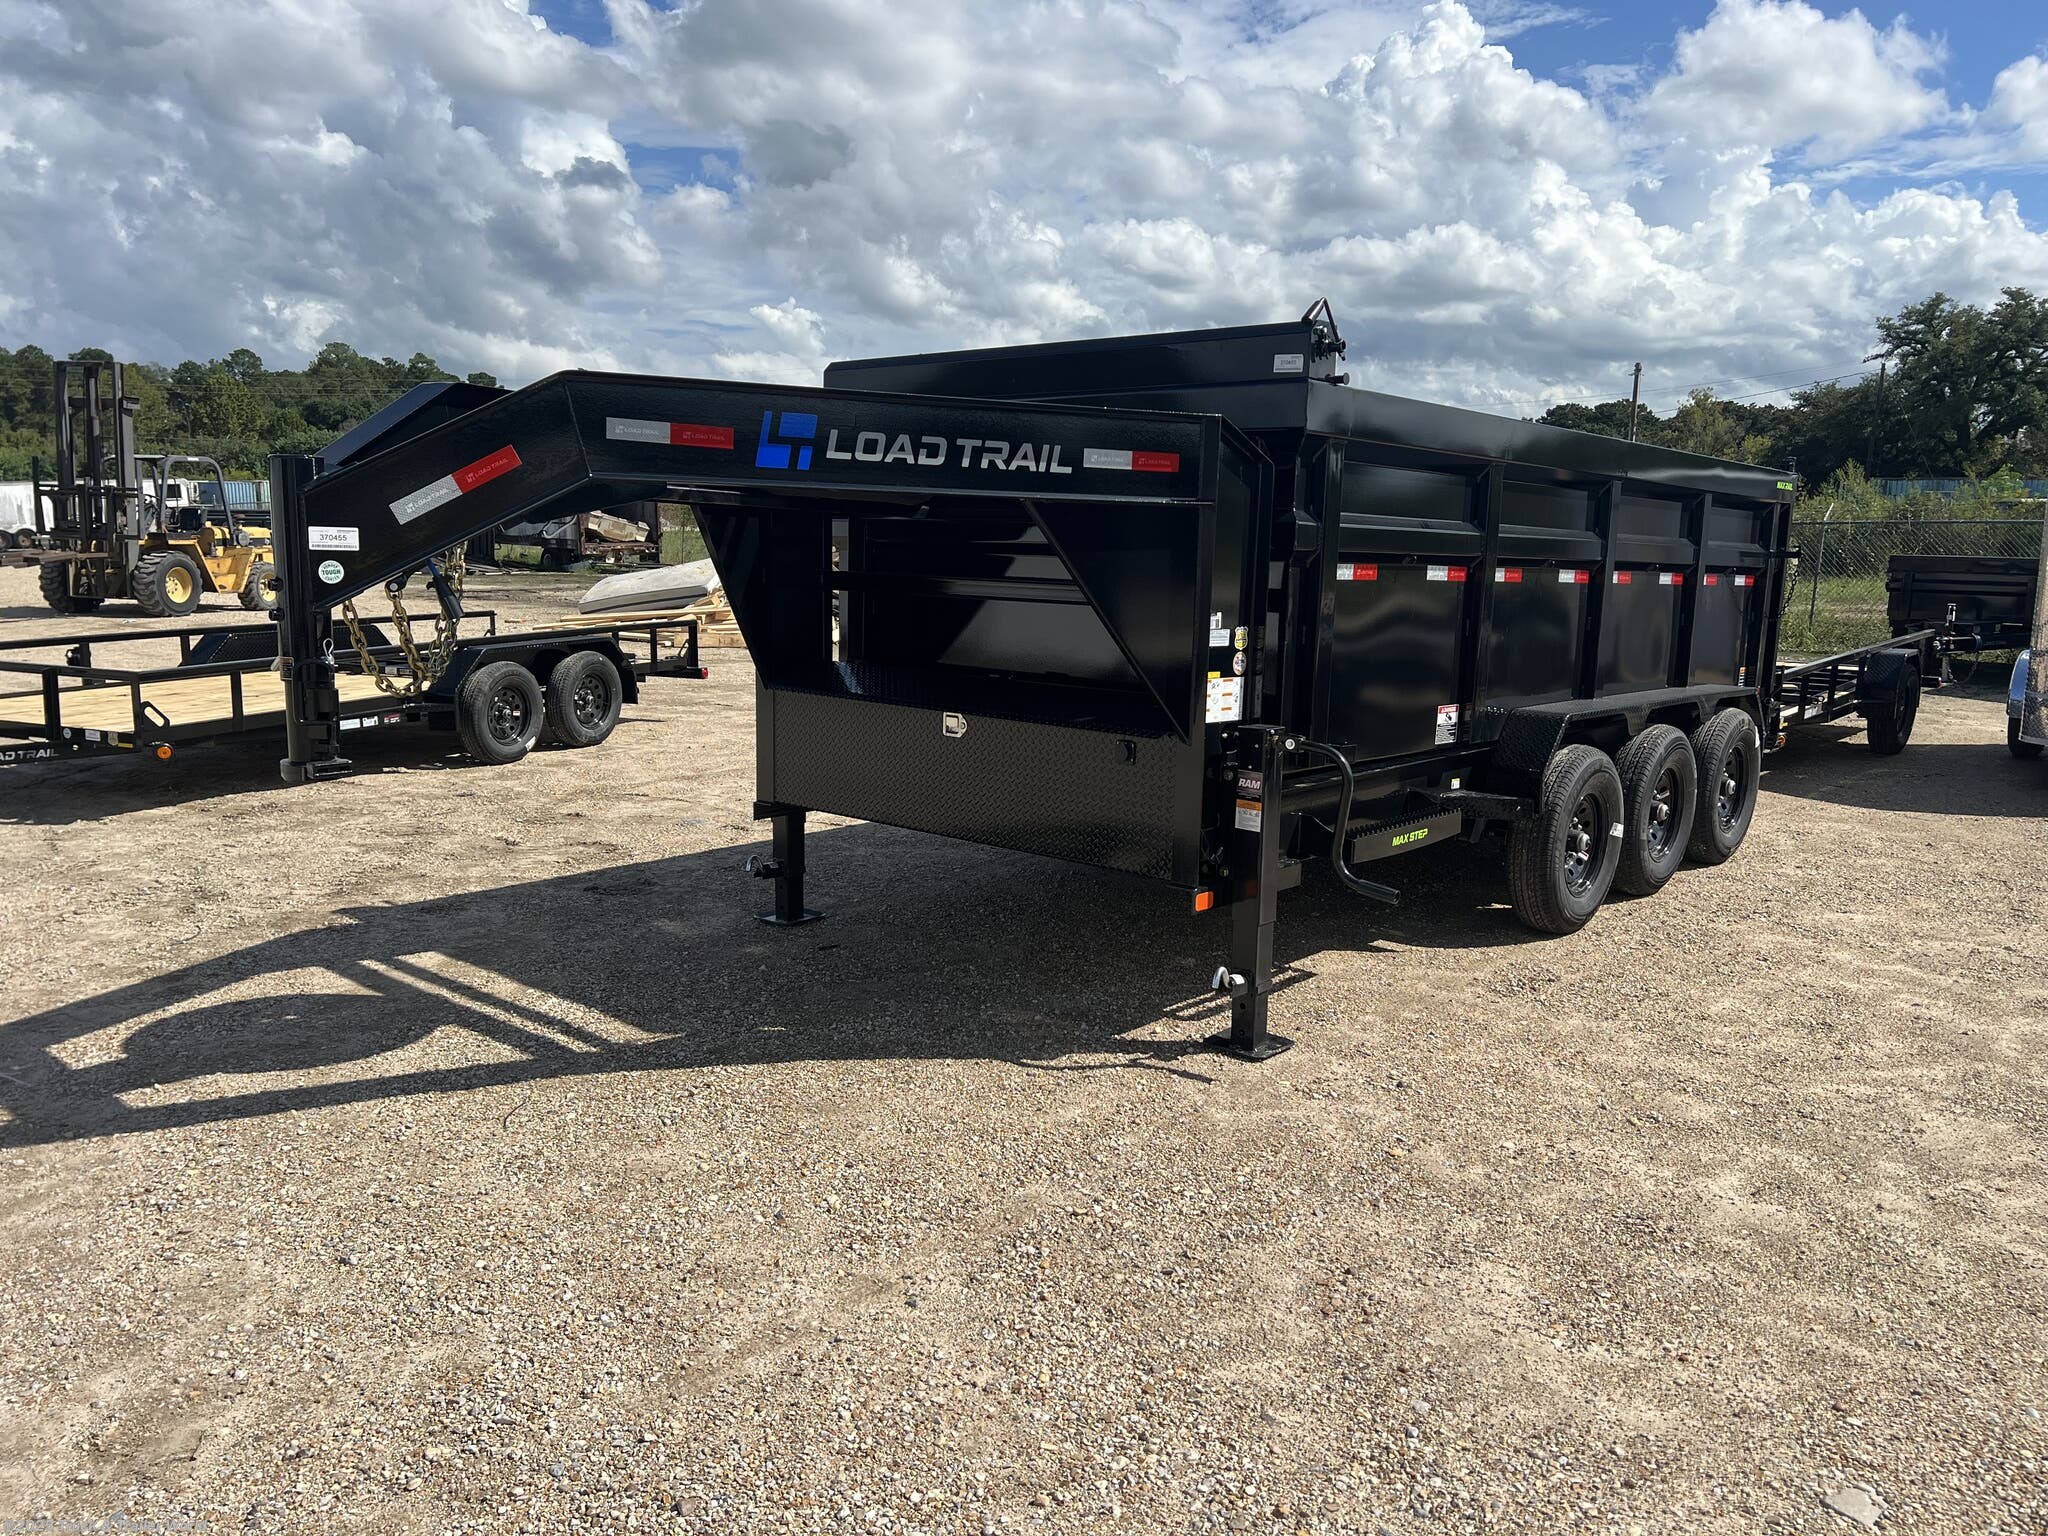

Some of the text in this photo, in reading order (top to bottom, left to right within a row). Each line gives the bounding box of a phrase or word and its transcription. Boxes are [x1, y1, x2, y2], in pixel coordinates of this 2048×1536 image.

[826, 429, 1073, 474] LOAD TRAIL
[17, 748, 60, 760] TRAIL
[1238, 778, 1261, 789] RAM
[1392, 828, 1428, 846] MAX STEP
